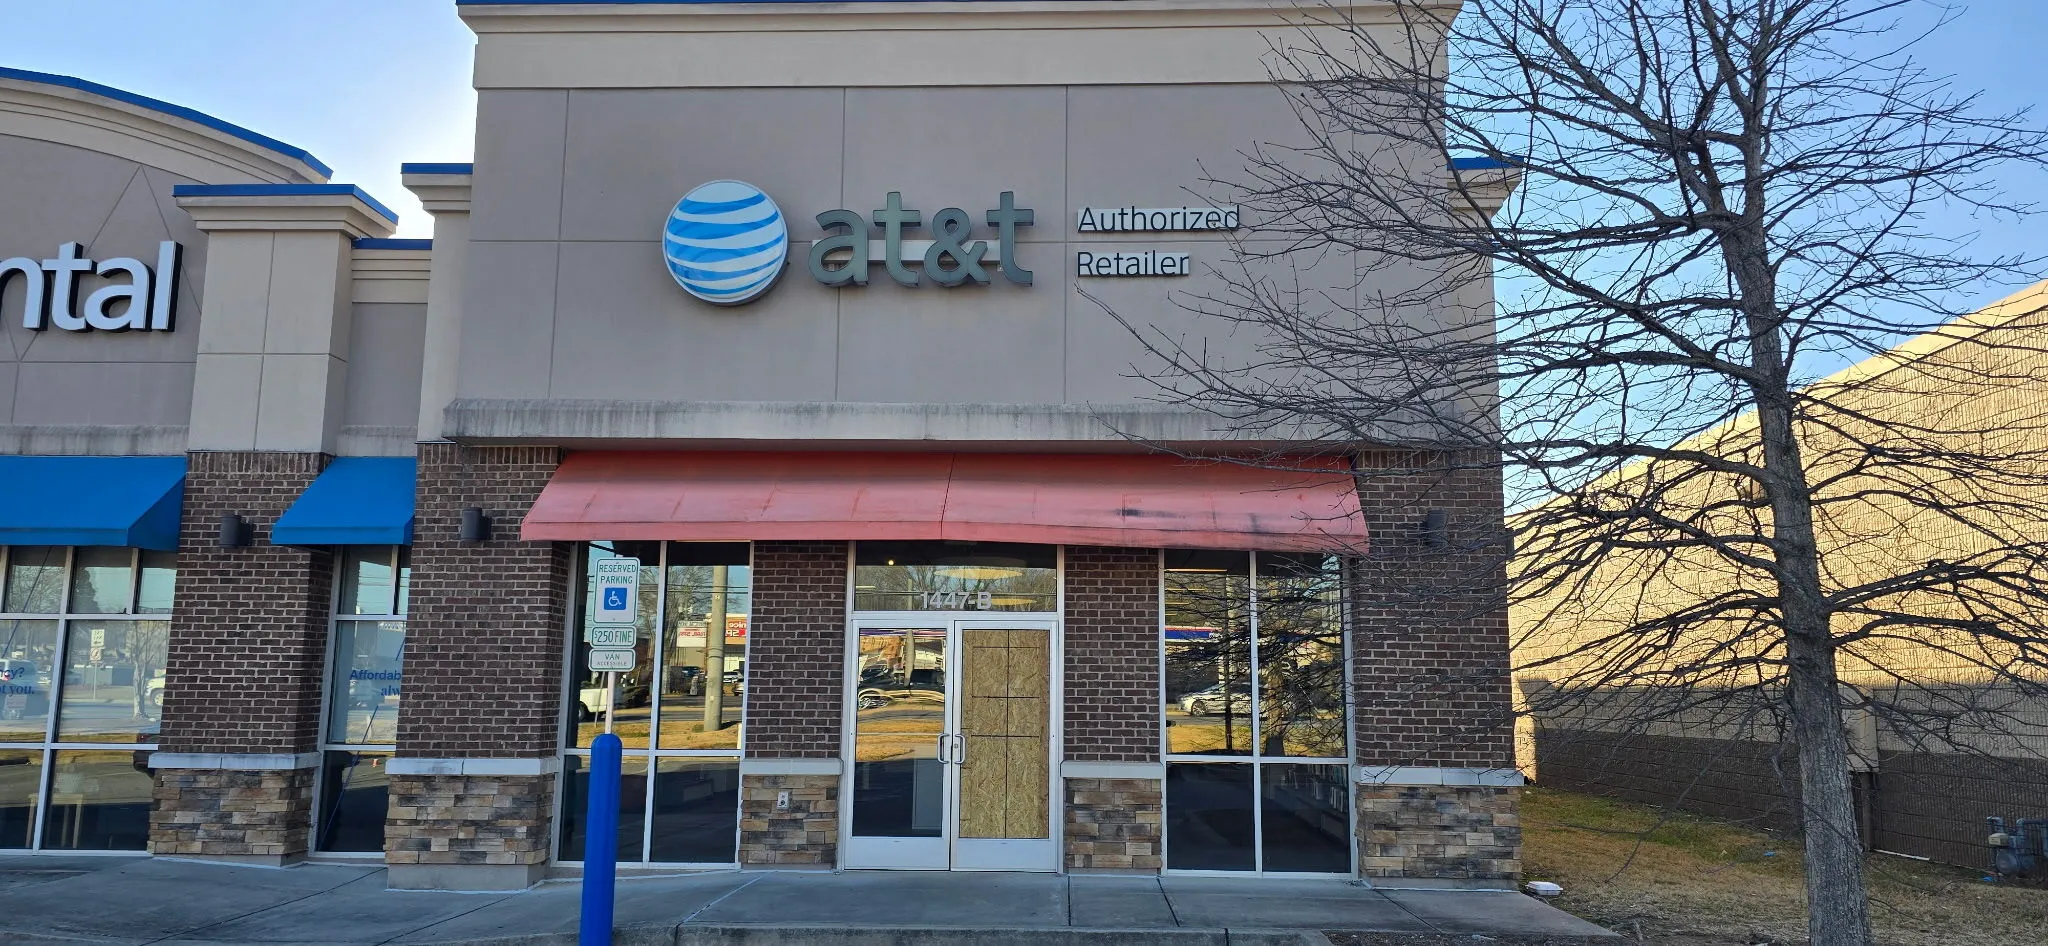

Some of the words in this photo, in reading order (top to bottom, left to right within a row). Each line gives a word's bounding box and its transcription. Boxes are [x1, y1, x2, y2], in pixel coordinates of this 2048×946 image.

[1078, 205, 1239, 232] Authorized
[808, 191, 1033, 287] at&t
[1078, 250, 1189, 277] Retailer
[599, 564, 636, 573] RESERVED
[600, 575, 633, 584] PARKING
[920, 590, 992, 609] 1447-B
[594, 630, 613, 643] $250
[614, 630, 633, 643] FINE
[605, 653, 621, 661] VAN
[9, 685, 35, 697] you.
